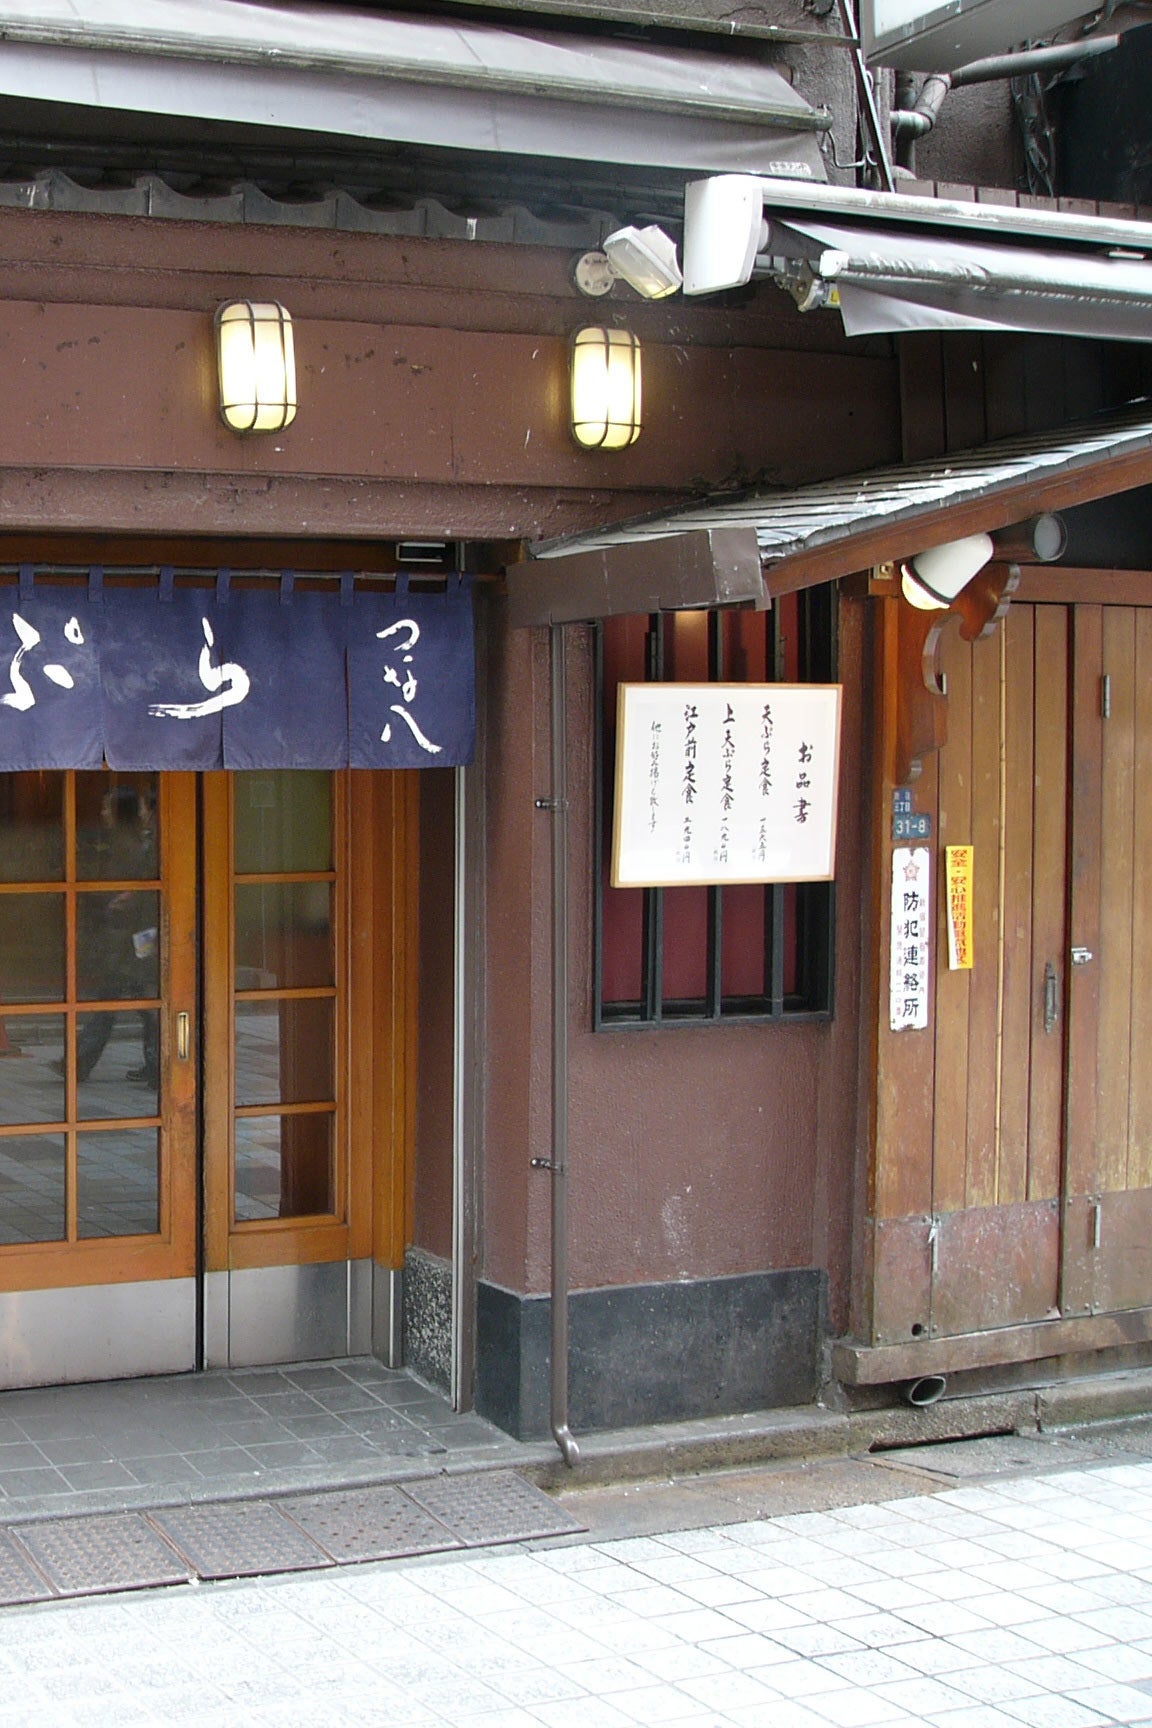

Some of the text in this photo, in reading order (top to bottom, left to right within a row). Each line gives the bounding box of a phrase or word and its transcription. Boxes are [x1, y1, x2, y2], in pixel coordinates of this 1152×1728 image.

[377, 619, 442, 753] つな八
[682, 704, 699, 804] 江戸前定食
[759, 704, 774, 796] 天ぷら定食
[793, 742, 814, 824] お品書
[896, 819, 926, 834] 31-8
[903, 891, 920, 1017] 防犯連絡所
